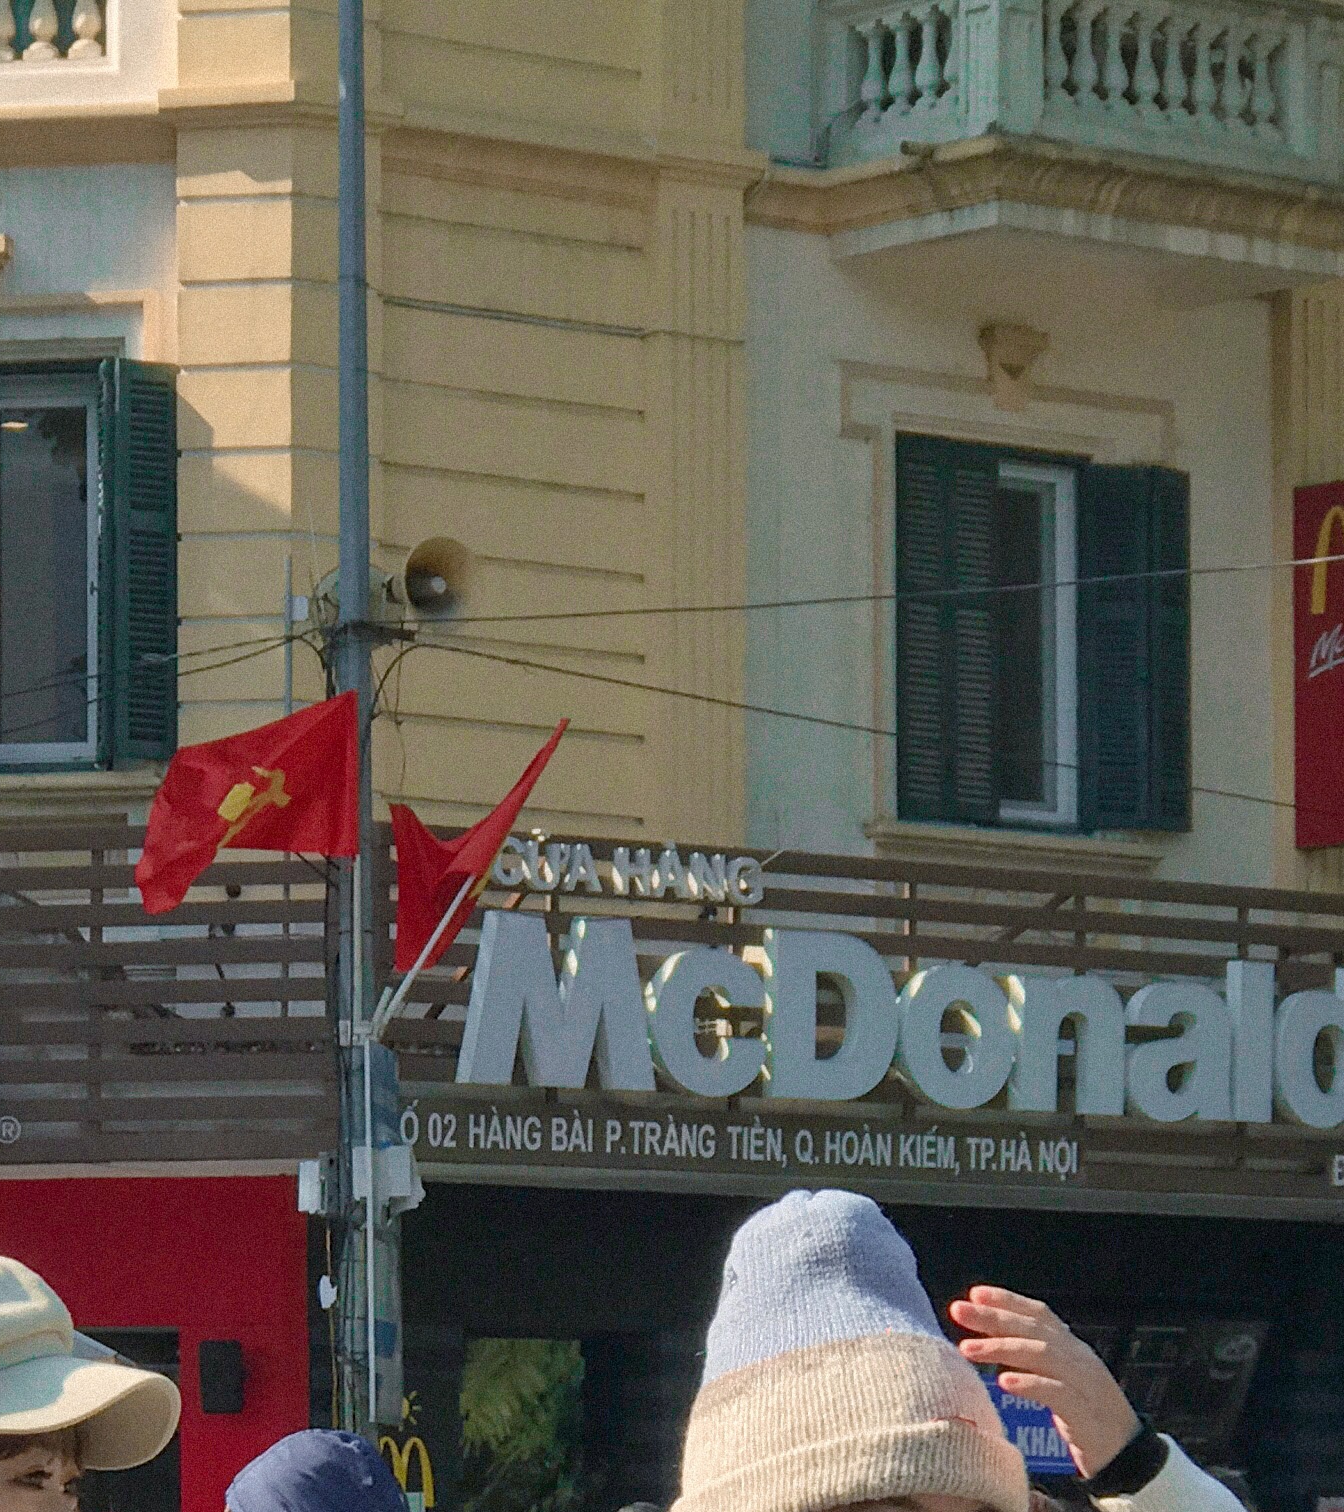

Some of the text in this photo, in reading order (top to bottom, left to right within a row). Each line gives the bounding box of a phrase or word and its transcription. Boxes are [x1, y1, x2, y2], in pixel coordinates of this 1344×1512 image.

[611, 840, 764, 905] HÀNG
[400, 1099, 420, 1147] Ố
[428, 1112, 457, 1148] 02
[468, 1106, 542, 1151] HÀNG
[551, 1109, 594, 1153] BÀI
[726, 1115, 788, 1169] TIỀN,
[899, 1125, 960, 1176] KIẾM,
[1038, 1136, 1079, 1181] NỘI
